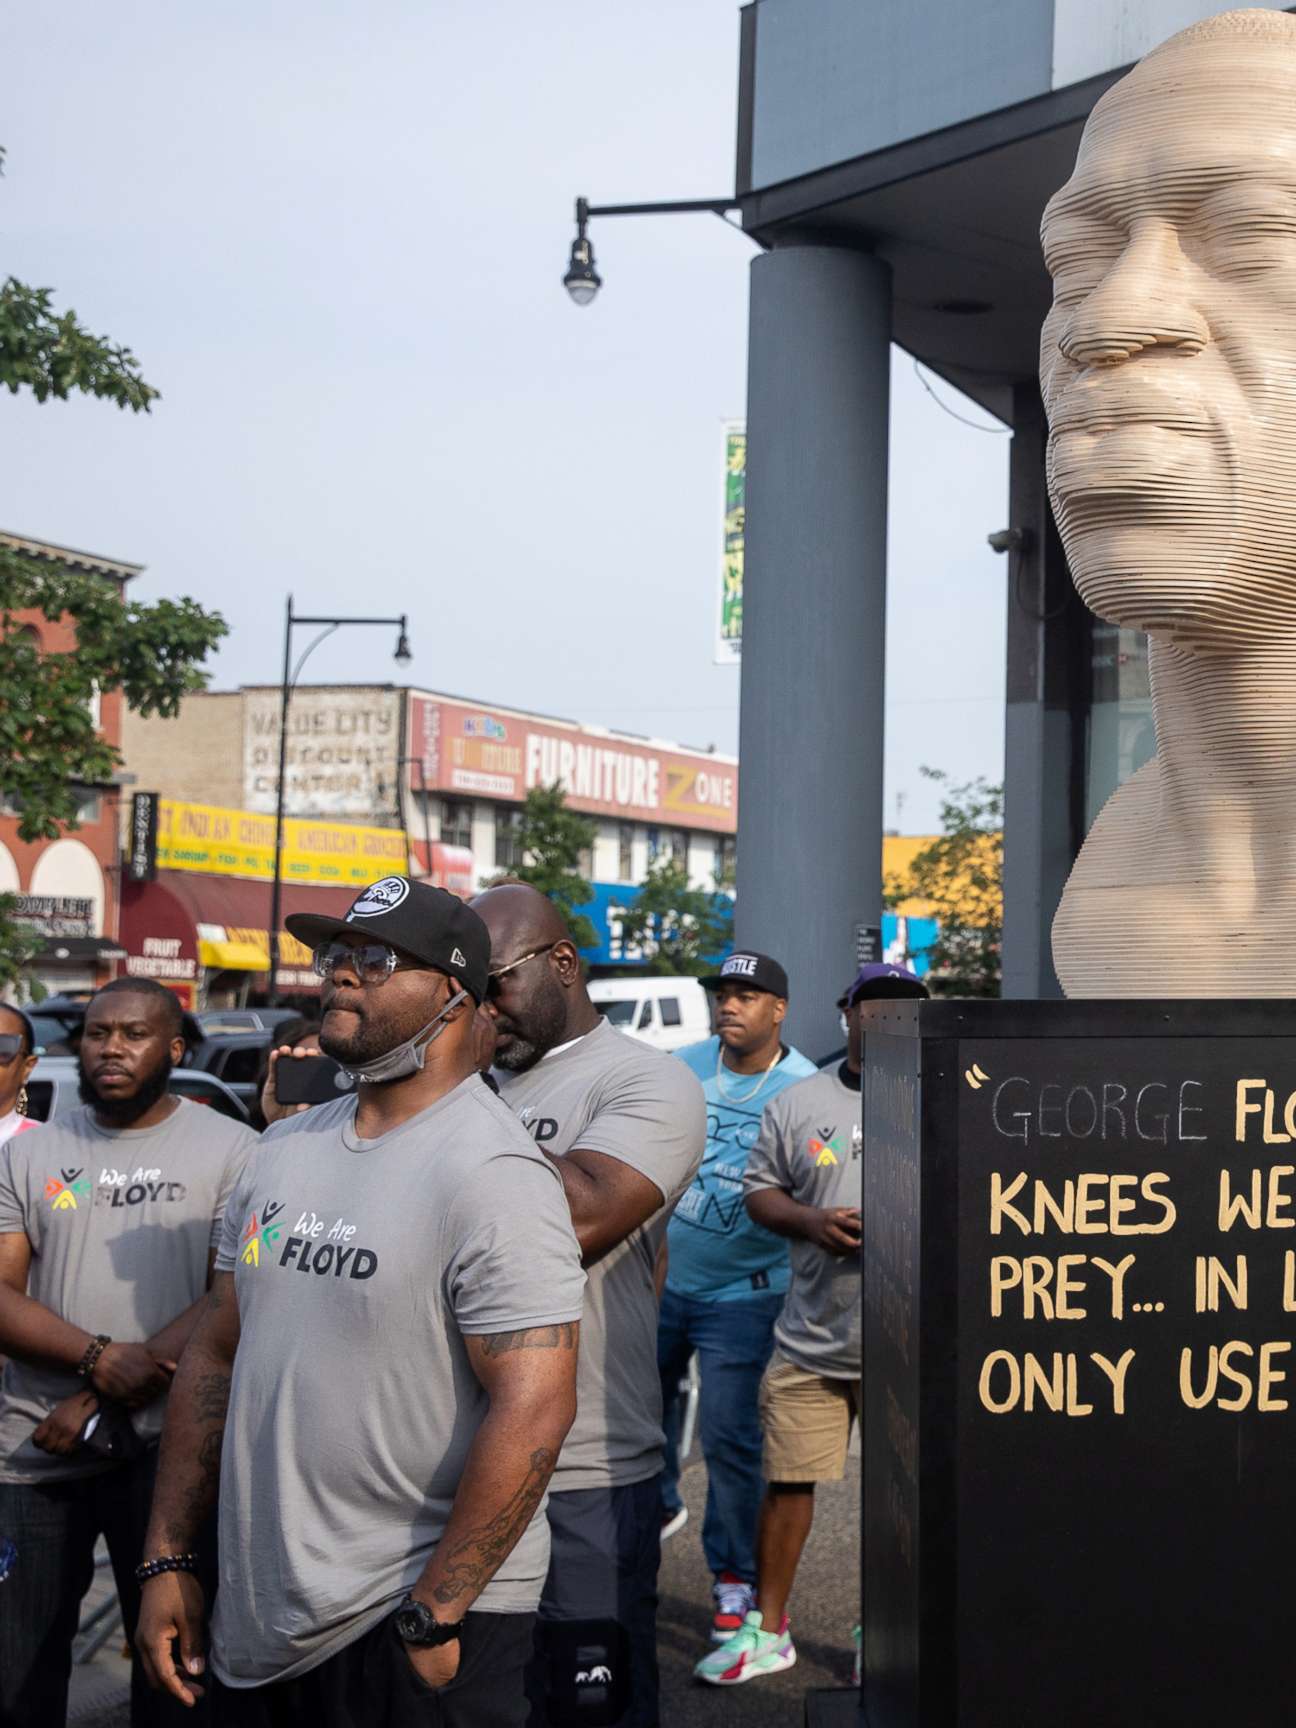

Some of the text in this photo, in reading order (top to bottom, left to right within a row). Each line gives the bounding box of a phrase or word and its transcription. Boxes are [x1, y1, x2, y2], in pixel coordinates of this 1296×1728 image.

[525, 733, 660, 809] FURNITURE
[94, 1181, 188, 1208] FLOYD
[99, 1166, 162, 1187] We Are
[990, 1171, 1177, 1236] KNEES
[293, 1211, 357, 1242] We Are
[278, 1236, 379, 1280] FLOYD
[990, 1253, 1165, 1321] PREY...
[1195, 1254, 1248, 1313] IN
[978, 1348, 1136, 1417] ONLY
[1179, 1340, 1292, 1412] USE
